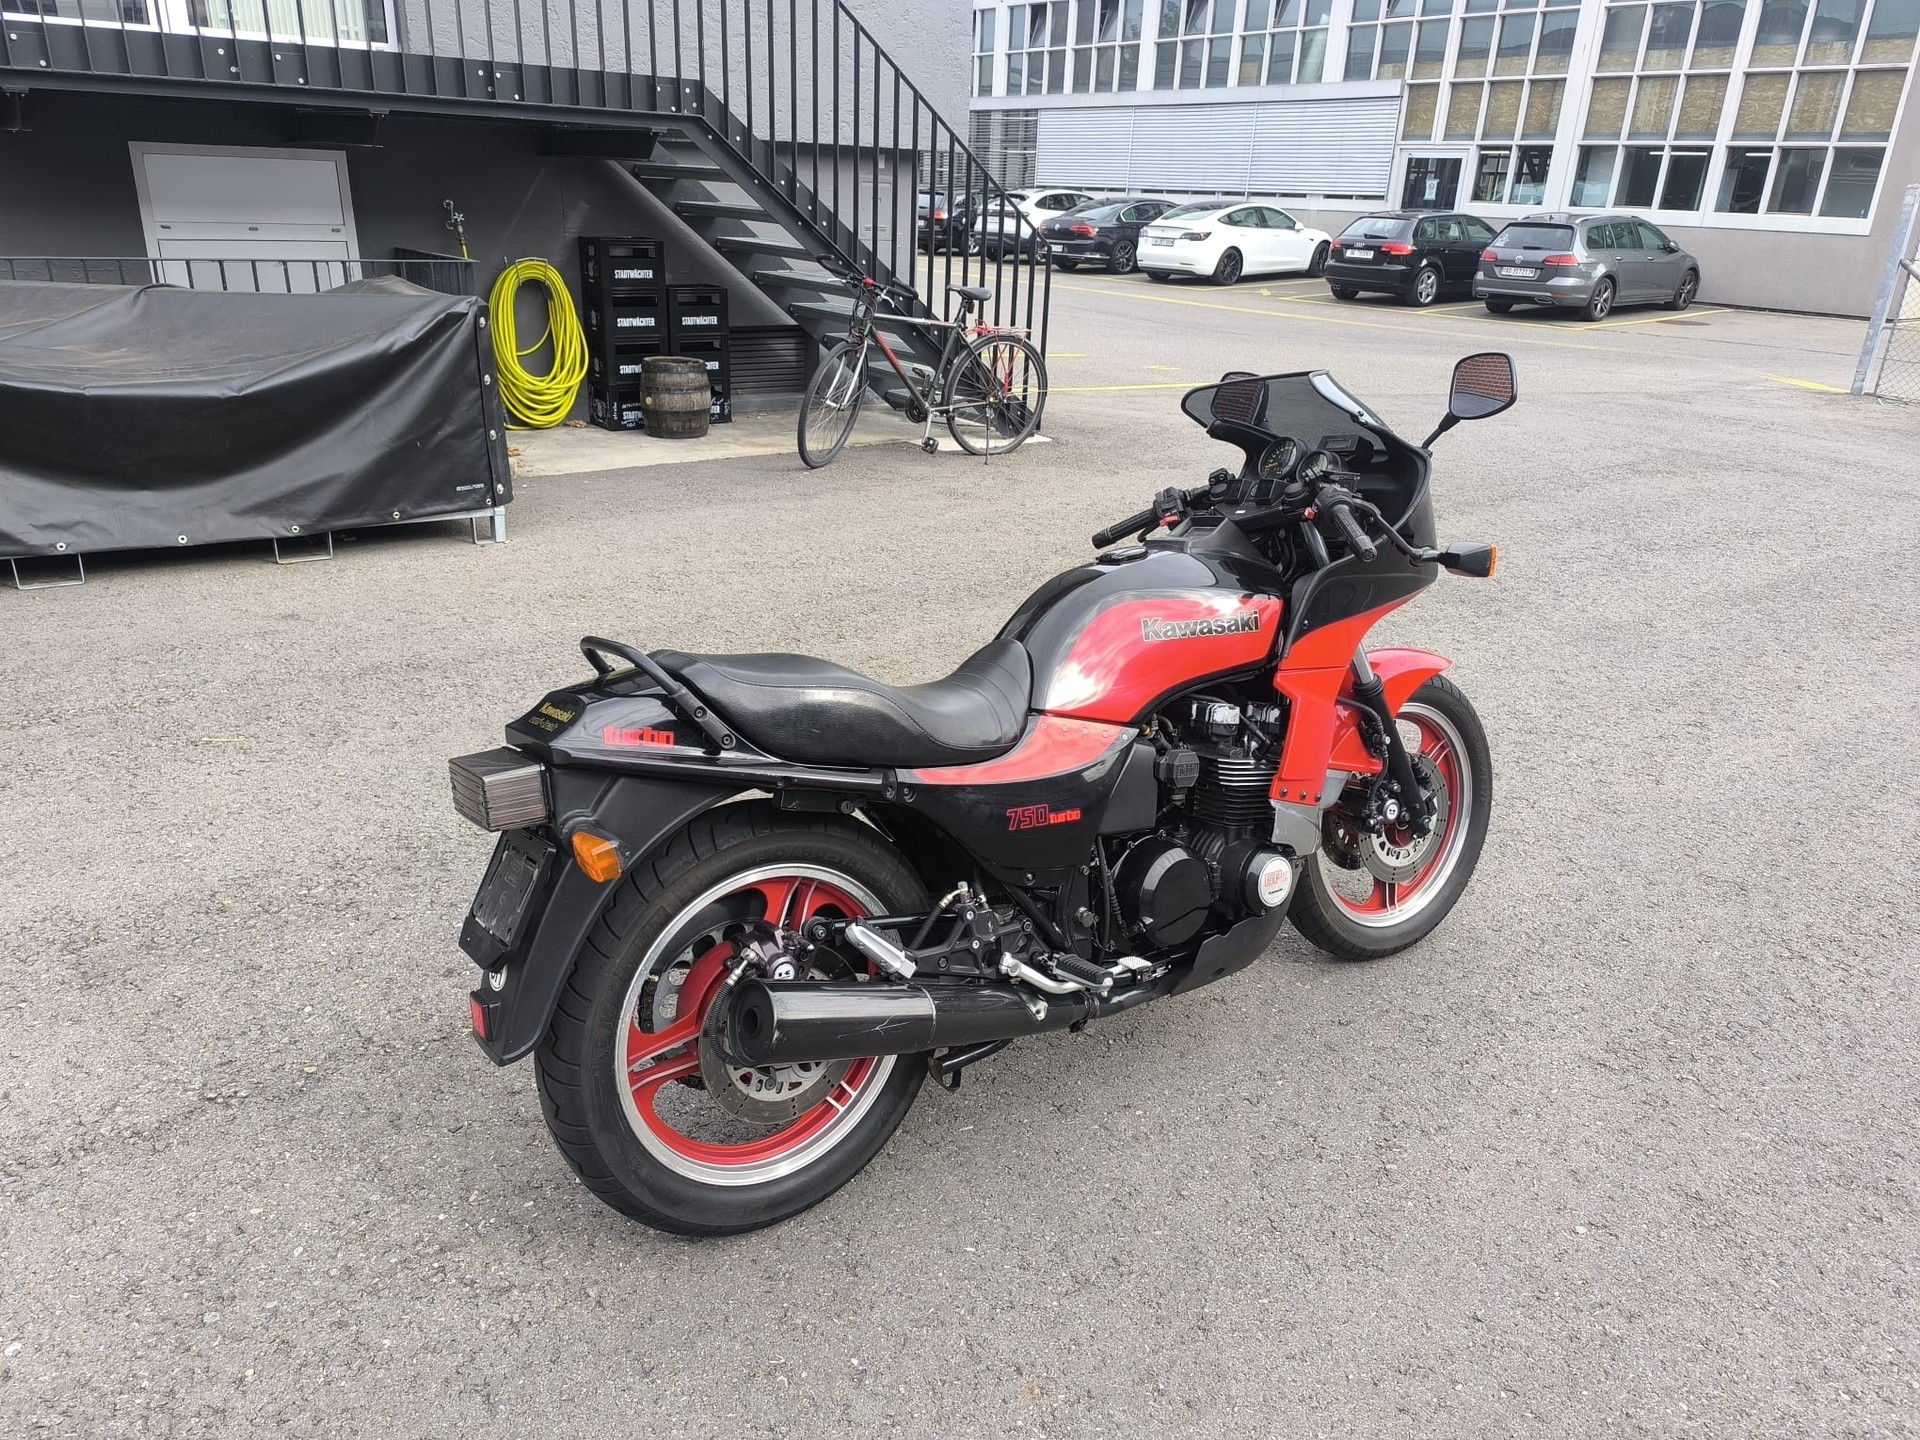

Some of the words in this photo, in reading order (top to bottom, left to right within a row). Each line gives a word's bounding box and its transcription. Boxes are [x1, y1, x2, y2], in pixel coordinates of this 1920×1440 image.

[614, 269, 653, 279] STADTWÄCHTER
[617, 316, 655, 327] STADTWÄCHTER
[682, 315, 718, 326] STADTWÄCHTER
[1141, 610, 1260, 641] Kawasaki
[540, 702, 575, 723] Kawasaki
[604, 726, 674, 748] turbo
[1006, 804, 1048, 831] 750
[1049, 809, 1081, 824] turbo
